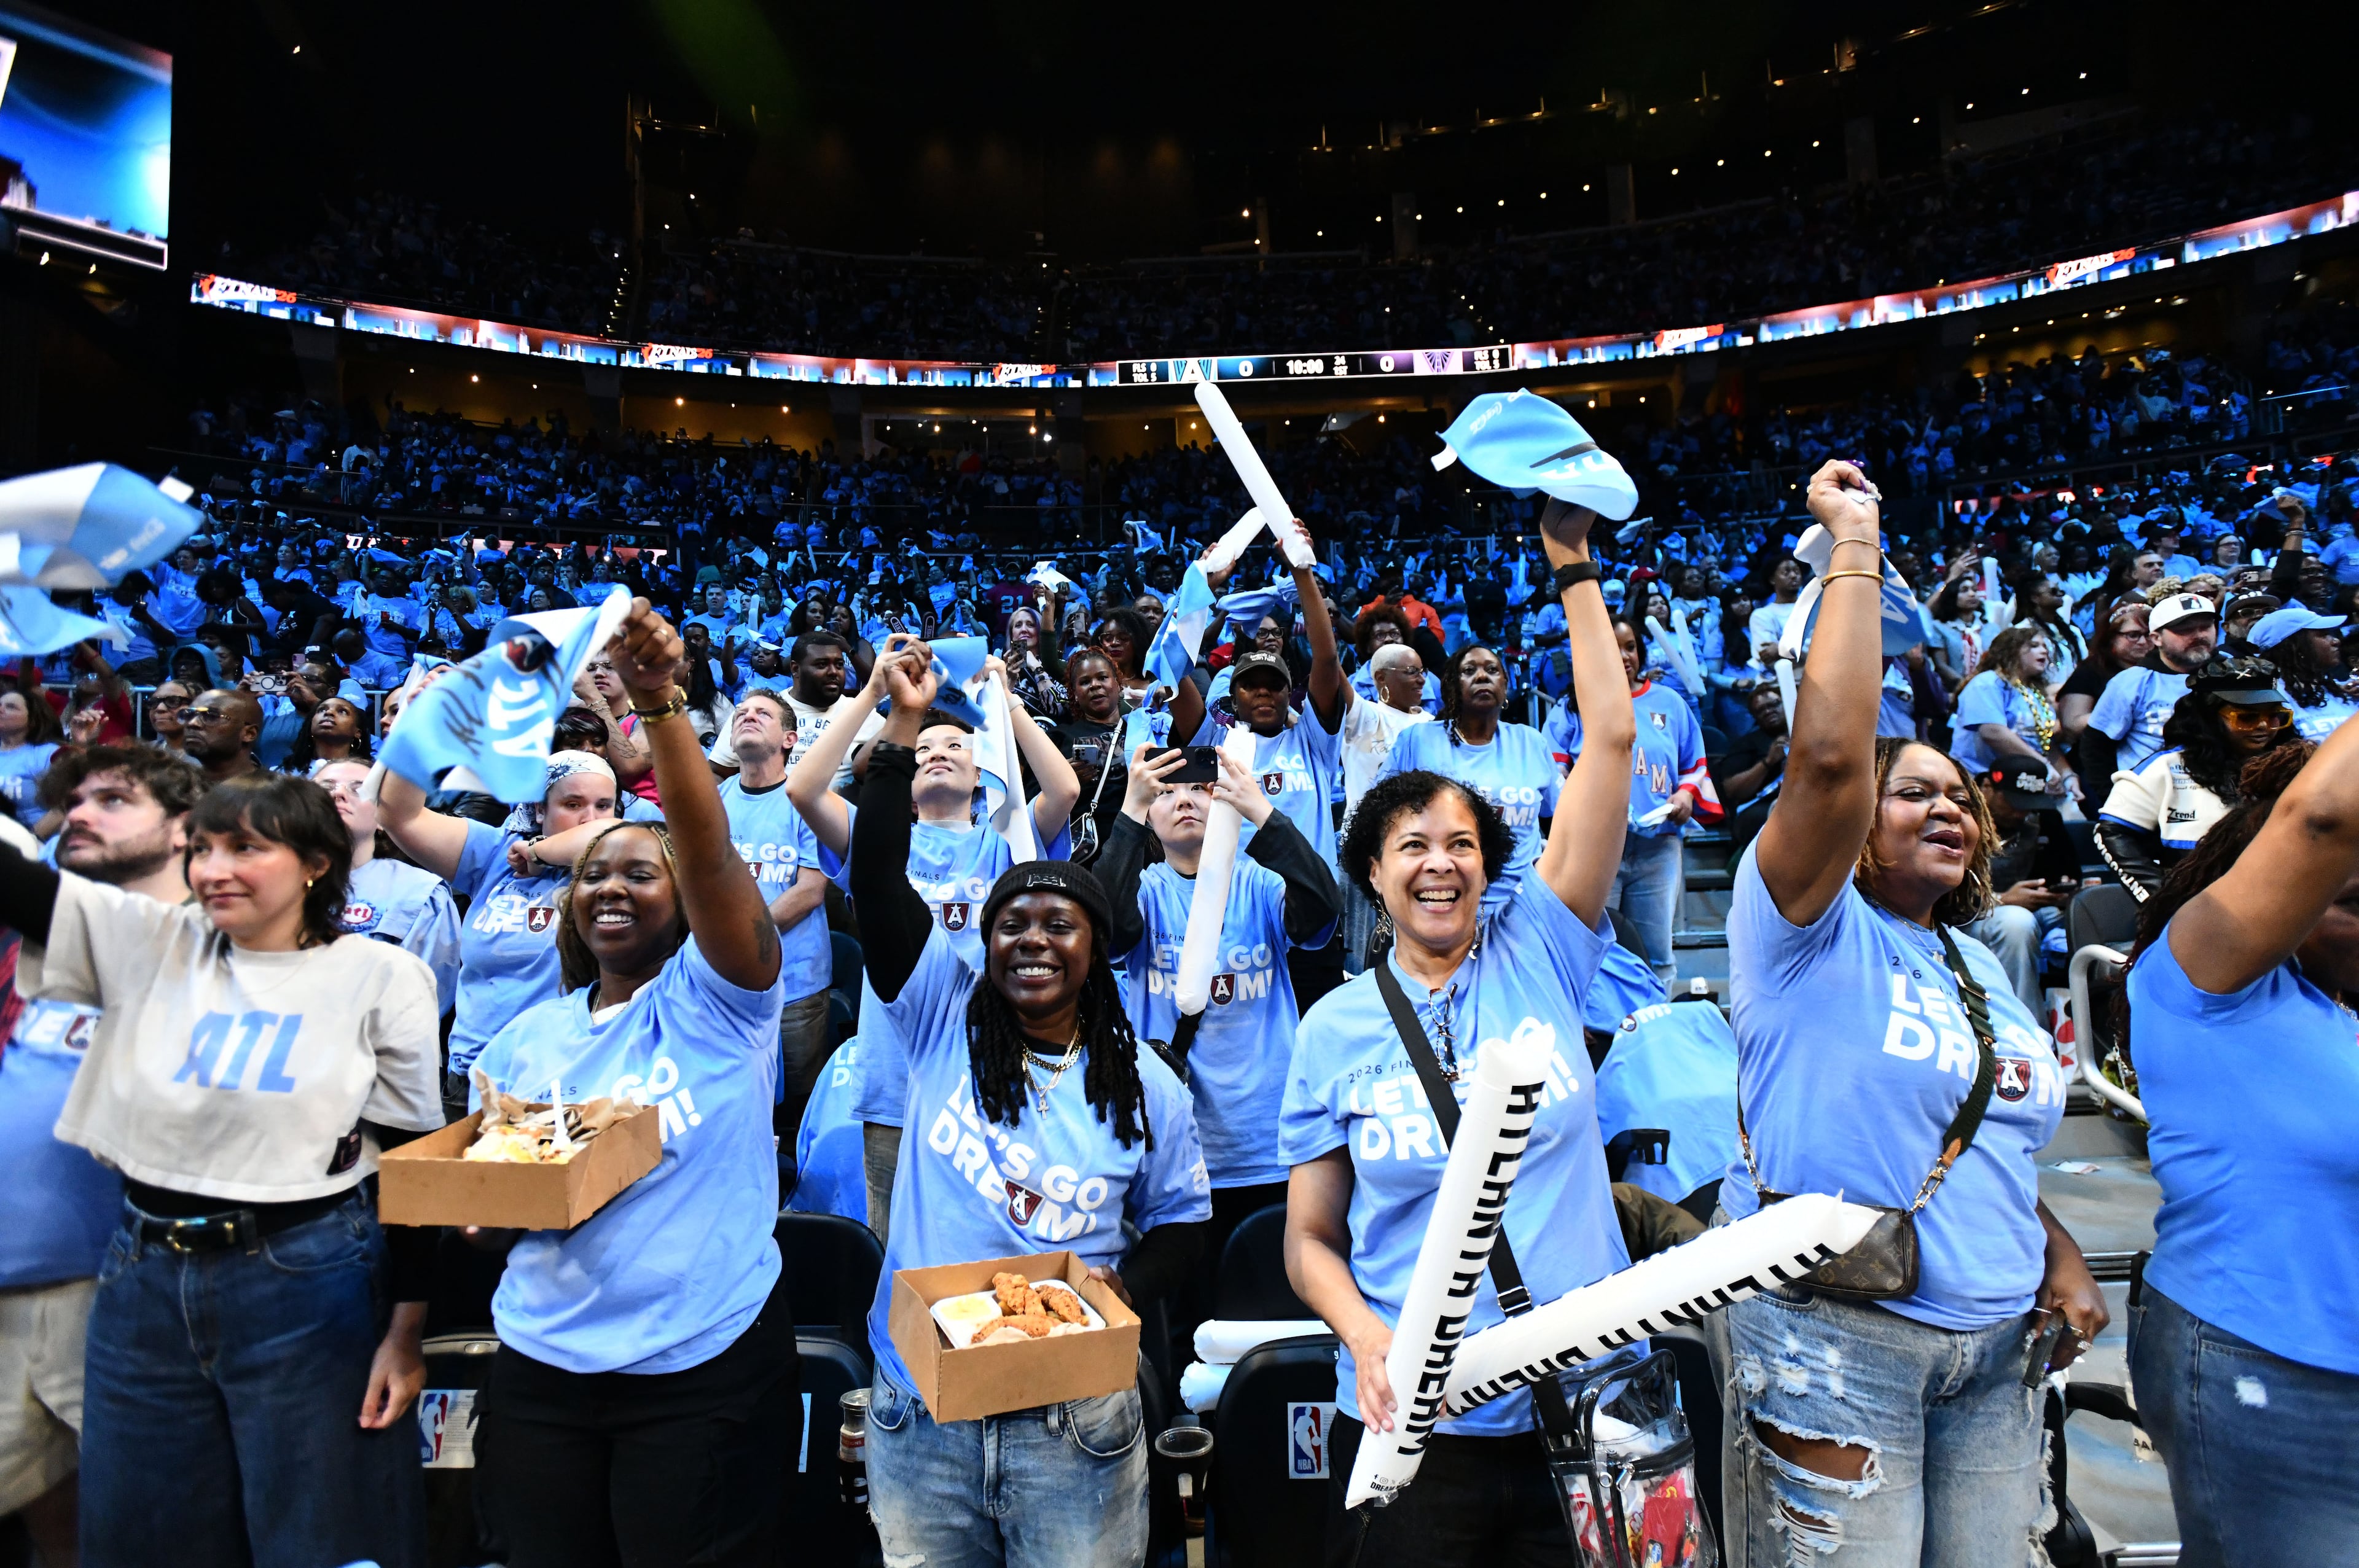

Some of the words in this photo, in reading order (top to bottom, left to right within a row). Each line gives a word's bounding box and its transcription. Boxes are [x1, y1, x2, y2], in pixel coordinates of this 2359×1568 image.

[213, 276, 276, 301] FINALS
[649, 343, 698, 362] FINALS
[1238, 360, 1254, 377] 0
[1286, 359, 1324, 375] 10:00
[1379, 356, 1395, 372] 0
[1001, 595, 1024, 614] 21
[1275, 754, 1305, 771] GO
[1500, 786, 1535, 805] GO
[759, 845, 797, 863] GO
[1169, 933, 1185, 942] FIN
[1227, 943, 1272, 971] GO
[1148, 969, 1274, 1002] DRAM!
[171, 1009, 304, 1094] ATL
[610, 1056, 679, 1106] GO
[1348, 1064, 1383, 1085] 2026
[1391, 1059, 1415, 1072] FIN
[534, 1086, 577, 1101] NALS
[1041, 1164, 1108, 1211] GO
[1297, 1459, 1312, 1471] NBA
